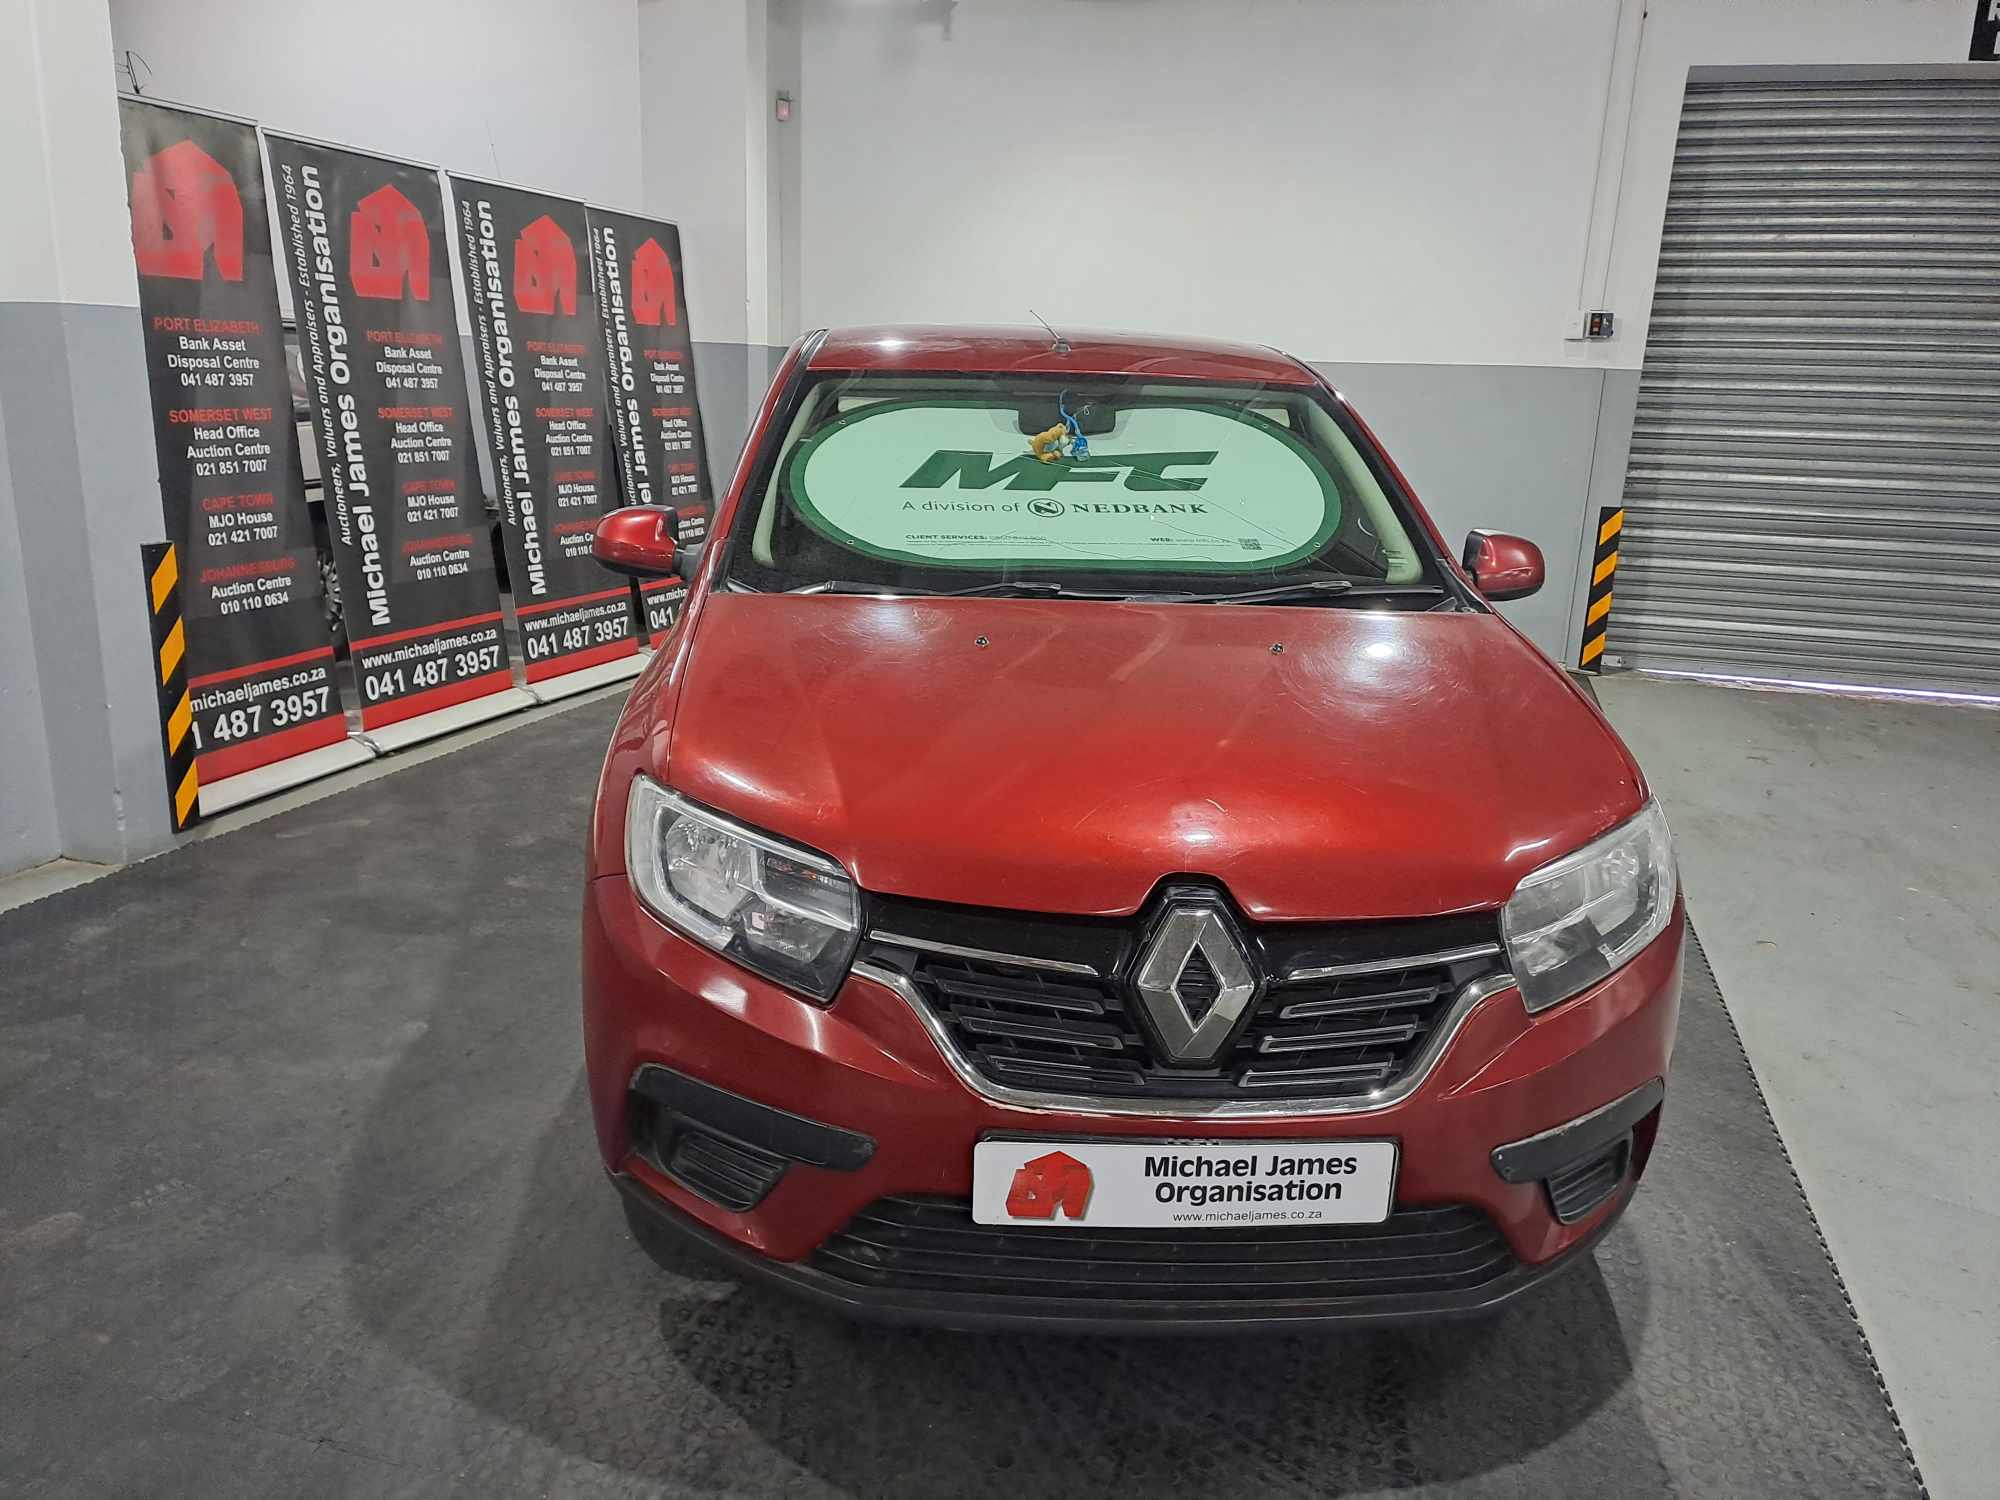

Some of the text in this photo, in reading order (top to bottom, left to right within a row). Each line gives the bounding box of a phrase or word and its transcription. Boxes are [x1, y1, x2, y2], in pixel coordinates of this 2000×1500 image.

[281, 164, 297, 200] 1964
[287, 204, 311, 287] Established
[603, 227, 634, 391] Organisation
[178, 336, 247, 351] Bank Asset
[304, 299, 325, 372] Appraisers
[167, 354, 260, 370] Disposal Centre
[384, 346, 432, 359] Bank Asset
[181, 373, 254, 386] 041 487 3957
[376, 361, 442, 375] Disposal Centre
[314, 375, 328, 404] and
[385, 378, 401, 389] 041
[486, 380, 499, 408] and
[301, 165, 391, 626] Michael James Organisation
[477, 200, 547, 596] Michael James Organisation
[169, 408, 273, 423] SOMERSET WEST
[395, 421, 444, 433] Head Office
[194, 425, 260, 440] Head Office
[321, 405, 337, 458] Valuers
[493, 408, 505, 450] Valuers
[627, 399, 648, 476] James
[186, 443, 271, 459] Auction Centre
[391, 436, 452, 449] Auction Centre
[196, 459, 268, 476] 021 851 7007
[397, 452, 413, 463] 021
[623, 451, 637, 505] uctioneers,
[898, 450, 1219, 491] MFC
[331, 463, 352, 545] Auctioneers,
[428, 494, 455, 505] House
[902, 501, 916, 511] A
[922, 500, 995, 512] division
[1001, 501, 1022, 512] of
[1073, 503, 1209, 515] NEDBANK
[208, 511, 273, 528] MJO House
[407, 511, 422, 522] 021
[423, 509, 438, 520] 421
[208, 526, 278, 546] 021 421 7007
[409, 549, 470, 567] Auction Centre
[417, 569, 431, 580] 010
[433, 565, 447, 577] 110
[211, 576, 292, 599] Auction Centre
[220, 600, 240, 615] 010
[242, 596, 262, 610] 110
[524, 601, 627, 632] www.michaeljames.co.za
[650, 606, 674, 629] 041
[361, 628, 497, 669] www.michaeljames.co.za
[527, 616, 628, 659] 041 487 3957
[365, 645, 499, 701] 041 487 3957
[190, 666, 327, 713] michaeljames.co.za
[213, 704, 262, 741] 487
[270, 686, 329, 726] 3957
[1144, 1155, 1358, 1178] Michael James
[1155, 1179, 1342, 1207] Organisation
[1173, 1209, 1322, 1223] www.michaeljames.co.za
